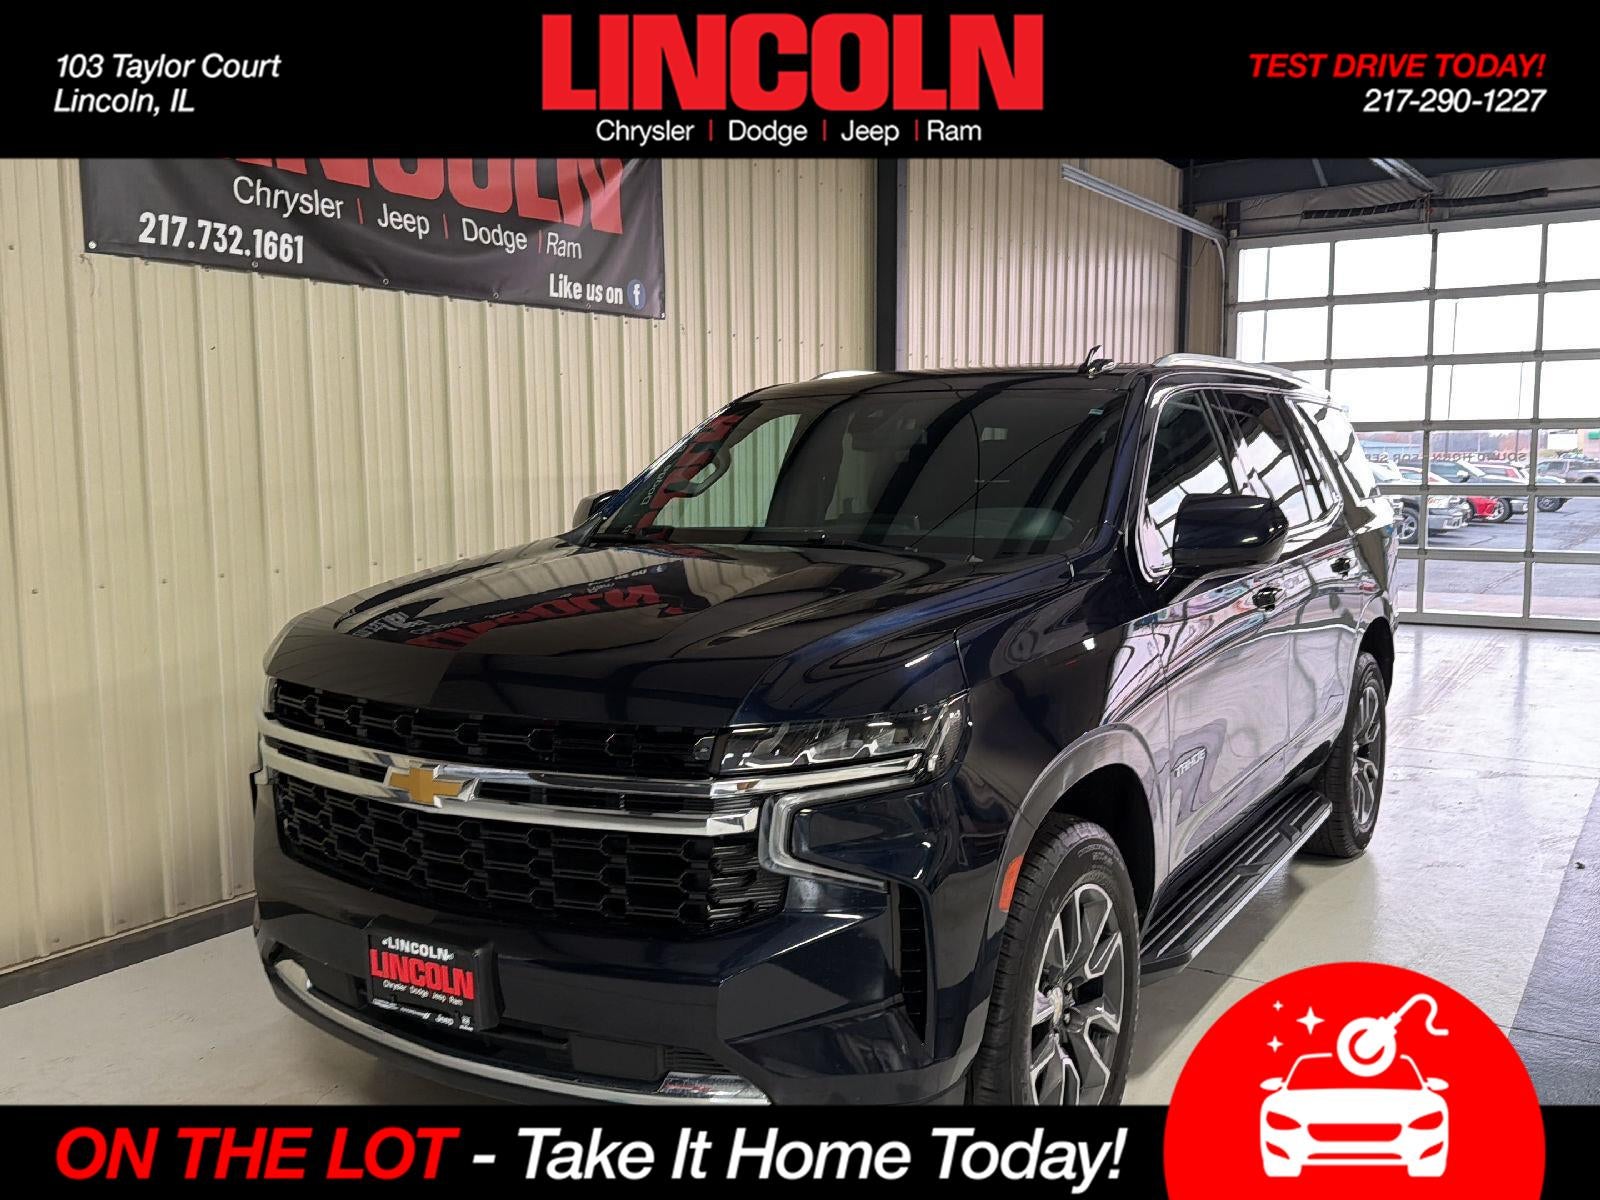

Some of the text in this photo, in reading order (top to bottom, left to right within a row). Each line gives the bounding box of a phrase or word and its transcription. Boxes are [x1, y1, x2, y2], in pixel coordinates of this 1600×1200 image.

[138, 211, 304, 264] 217.732.1661
[233, 176, 344, 219] Chrysler
[377, 203, 430, 240] Jeep
[461, 217, 528, 254] Dodge
[546, 232, 582, 259] Ram
[549, 273, 583, 300] Like
[586, 282, 603, 303] us
[606, 285, 623, 305] on
[386, 936, 450, 961] LINCOLN
[369, 949, 474, 1000] LINCOLN
